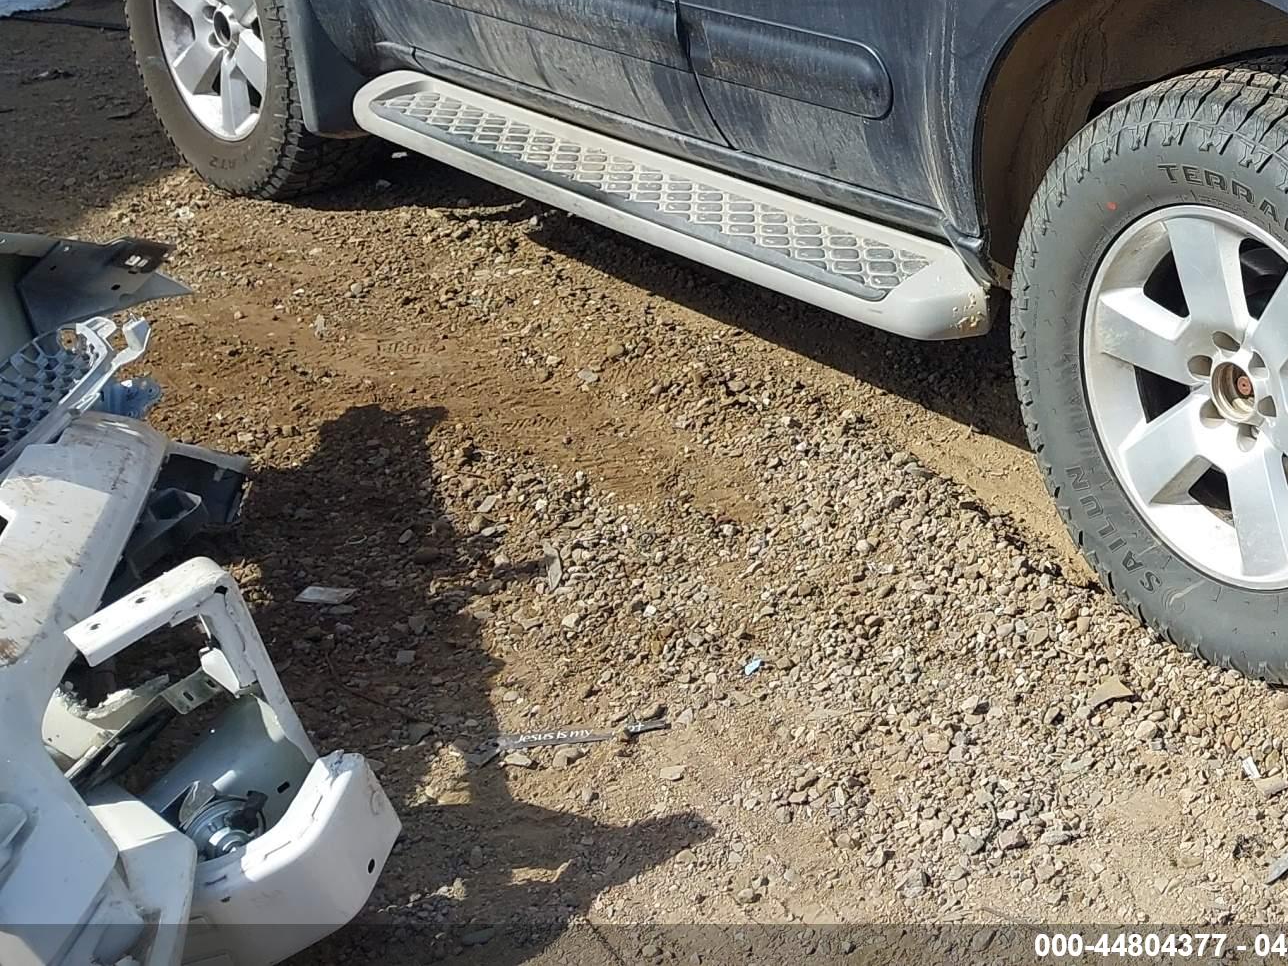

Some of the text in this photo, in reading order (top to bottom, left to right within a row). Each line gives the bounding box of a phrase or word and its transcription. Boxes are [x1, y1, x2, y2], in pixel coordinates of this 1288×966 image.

[1065, 465, 1162, 594] SAILUN
[515, 732, 554, 744] Jesus
[571, 728, 594, 738] my
